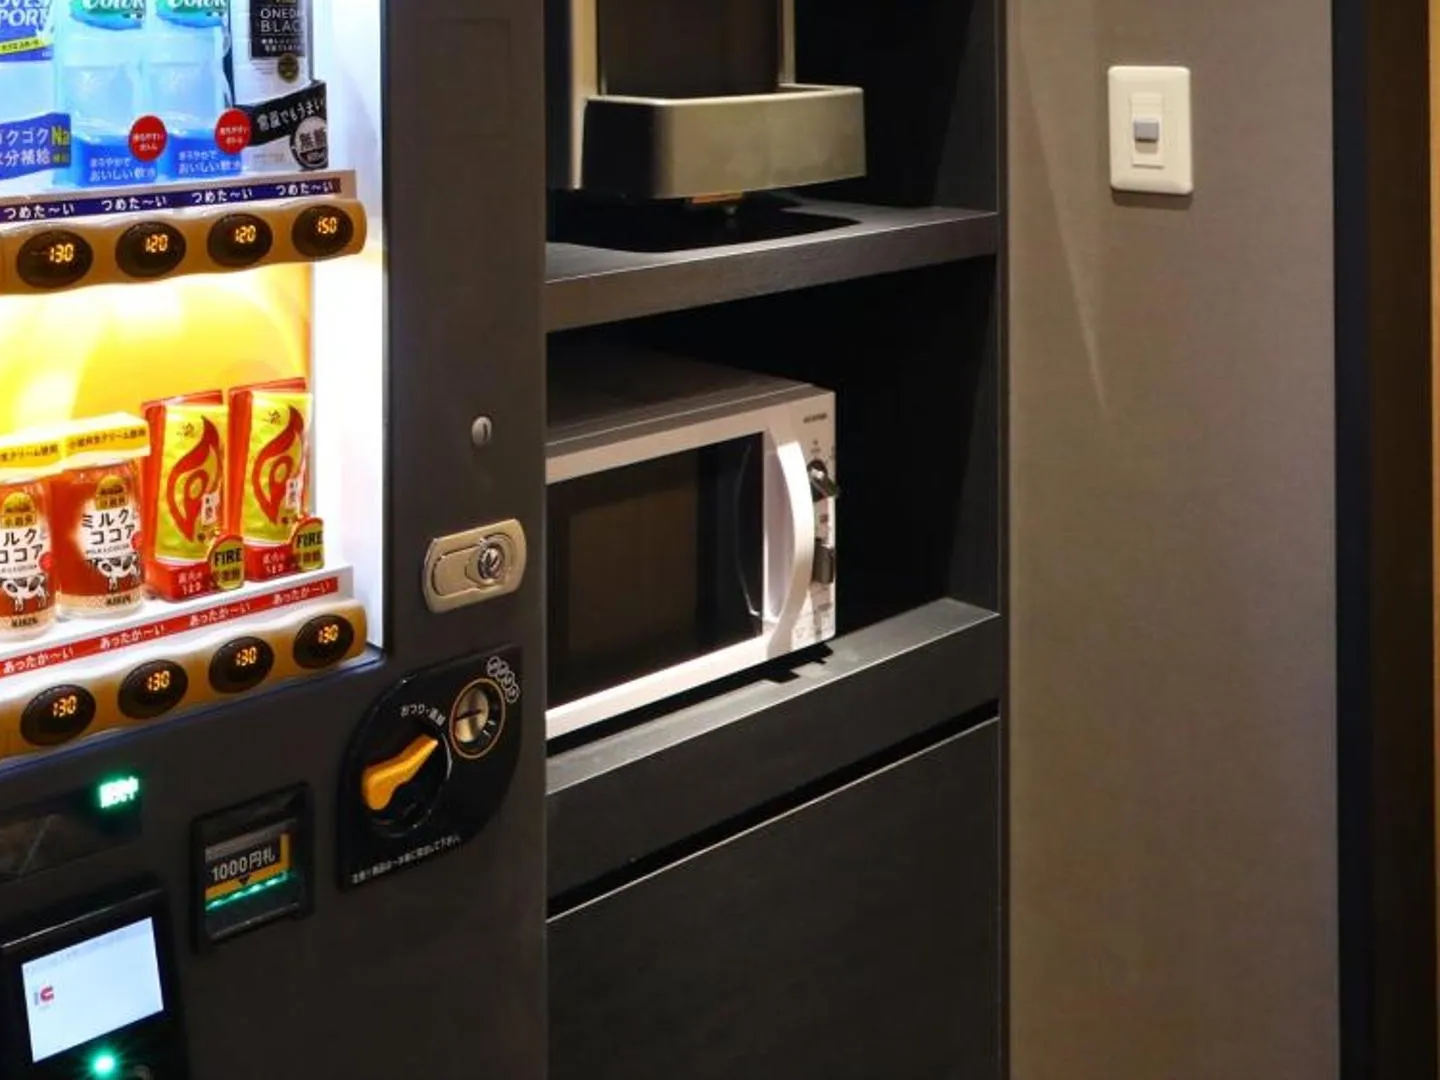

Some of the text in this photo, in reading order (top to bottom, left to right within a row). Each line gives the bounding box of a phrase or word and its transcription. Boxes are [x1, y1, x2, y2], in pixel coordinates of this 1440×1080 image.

[234, 225, 256, 243] 120
[317, 217, 337, 234] 150
[49, 244, 73, 262] 130
[145, 234, 168, 253] 120
[91, 524, 135, 545] ココア
[296, 531, 323, 547] FIRE
[214, 548, 242, 567] FIRE
[317, 625, 339, 644] 130
[235, 647, 257, 667] 130
[147, 671, 170, 691] 130
[52, 696, 77, 718] 130
[211, 847, 275, 880] 1000円札
